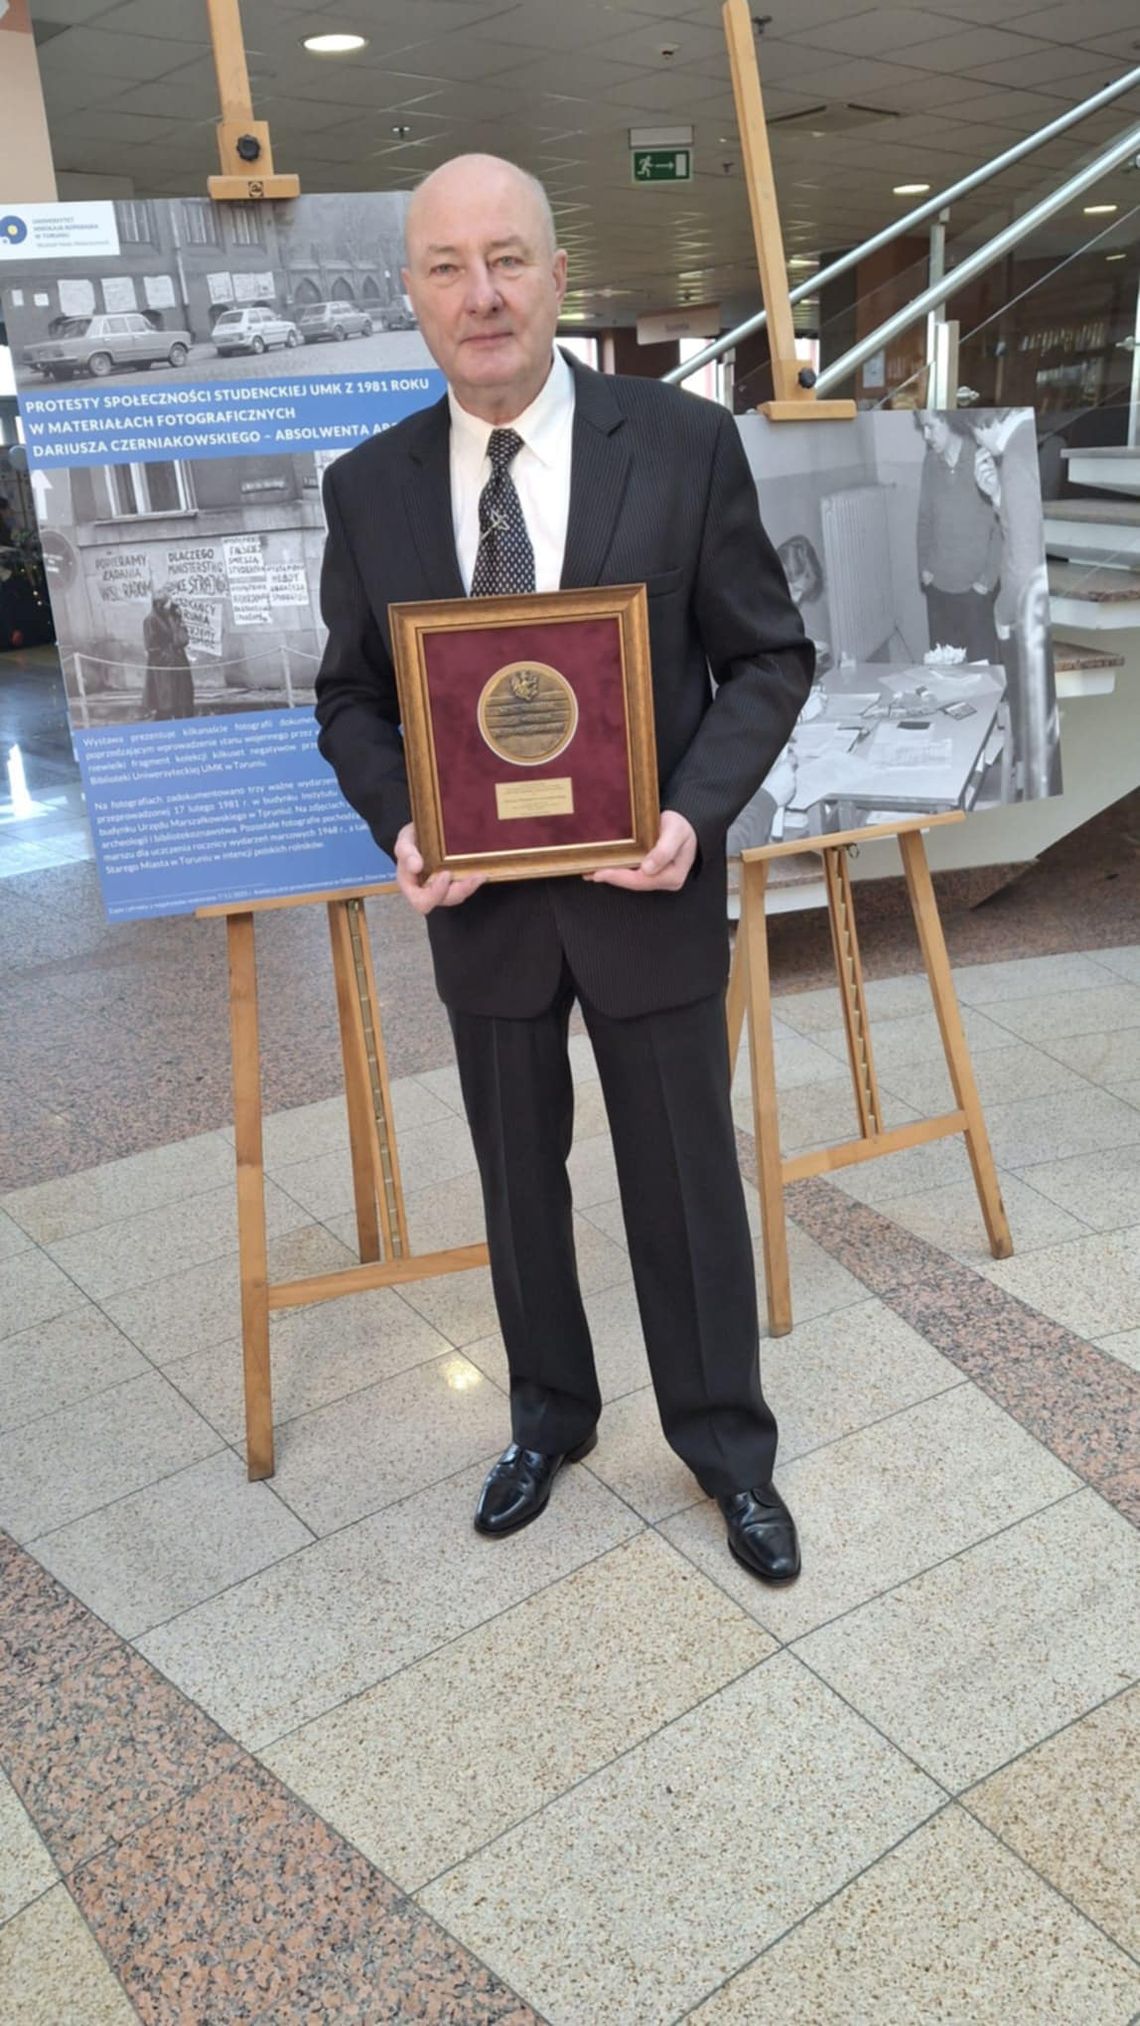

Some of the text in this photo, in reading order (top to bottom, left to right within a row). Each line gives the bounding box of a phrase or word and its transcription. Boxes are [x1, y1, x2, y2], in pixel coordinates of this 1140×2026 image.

[25, 378, 429, 413] PROTESTY SPOŁECZNOŚCI STUDENCKIEJ UMK Z 1981 ROKU
[29, 408, 295, 435] W MATERIAŁACH FOTOGRAFICZNYCH
[33, 441, 108, 458] DARIUSZA
[111, 431, 260, 451] CZERNIAKOWSKIEGO
[275, 425, 369, 441] ABSOLWENTA
[168, 548, 214, 562] DLACZEGO
[83, 736, 123, 747] Wystawa
[90, 774, 131, 785] Biblioteki
[132, 765, 200, 781] Uniwersyteckiej
[200, 763, 224, 773] UMK
[94, 802, 108, 810] Na
[105, 863, 140, 874] Starego
[140, 860, 169, 870] Miasta
[179, 855, 213, 865] Toruniu
